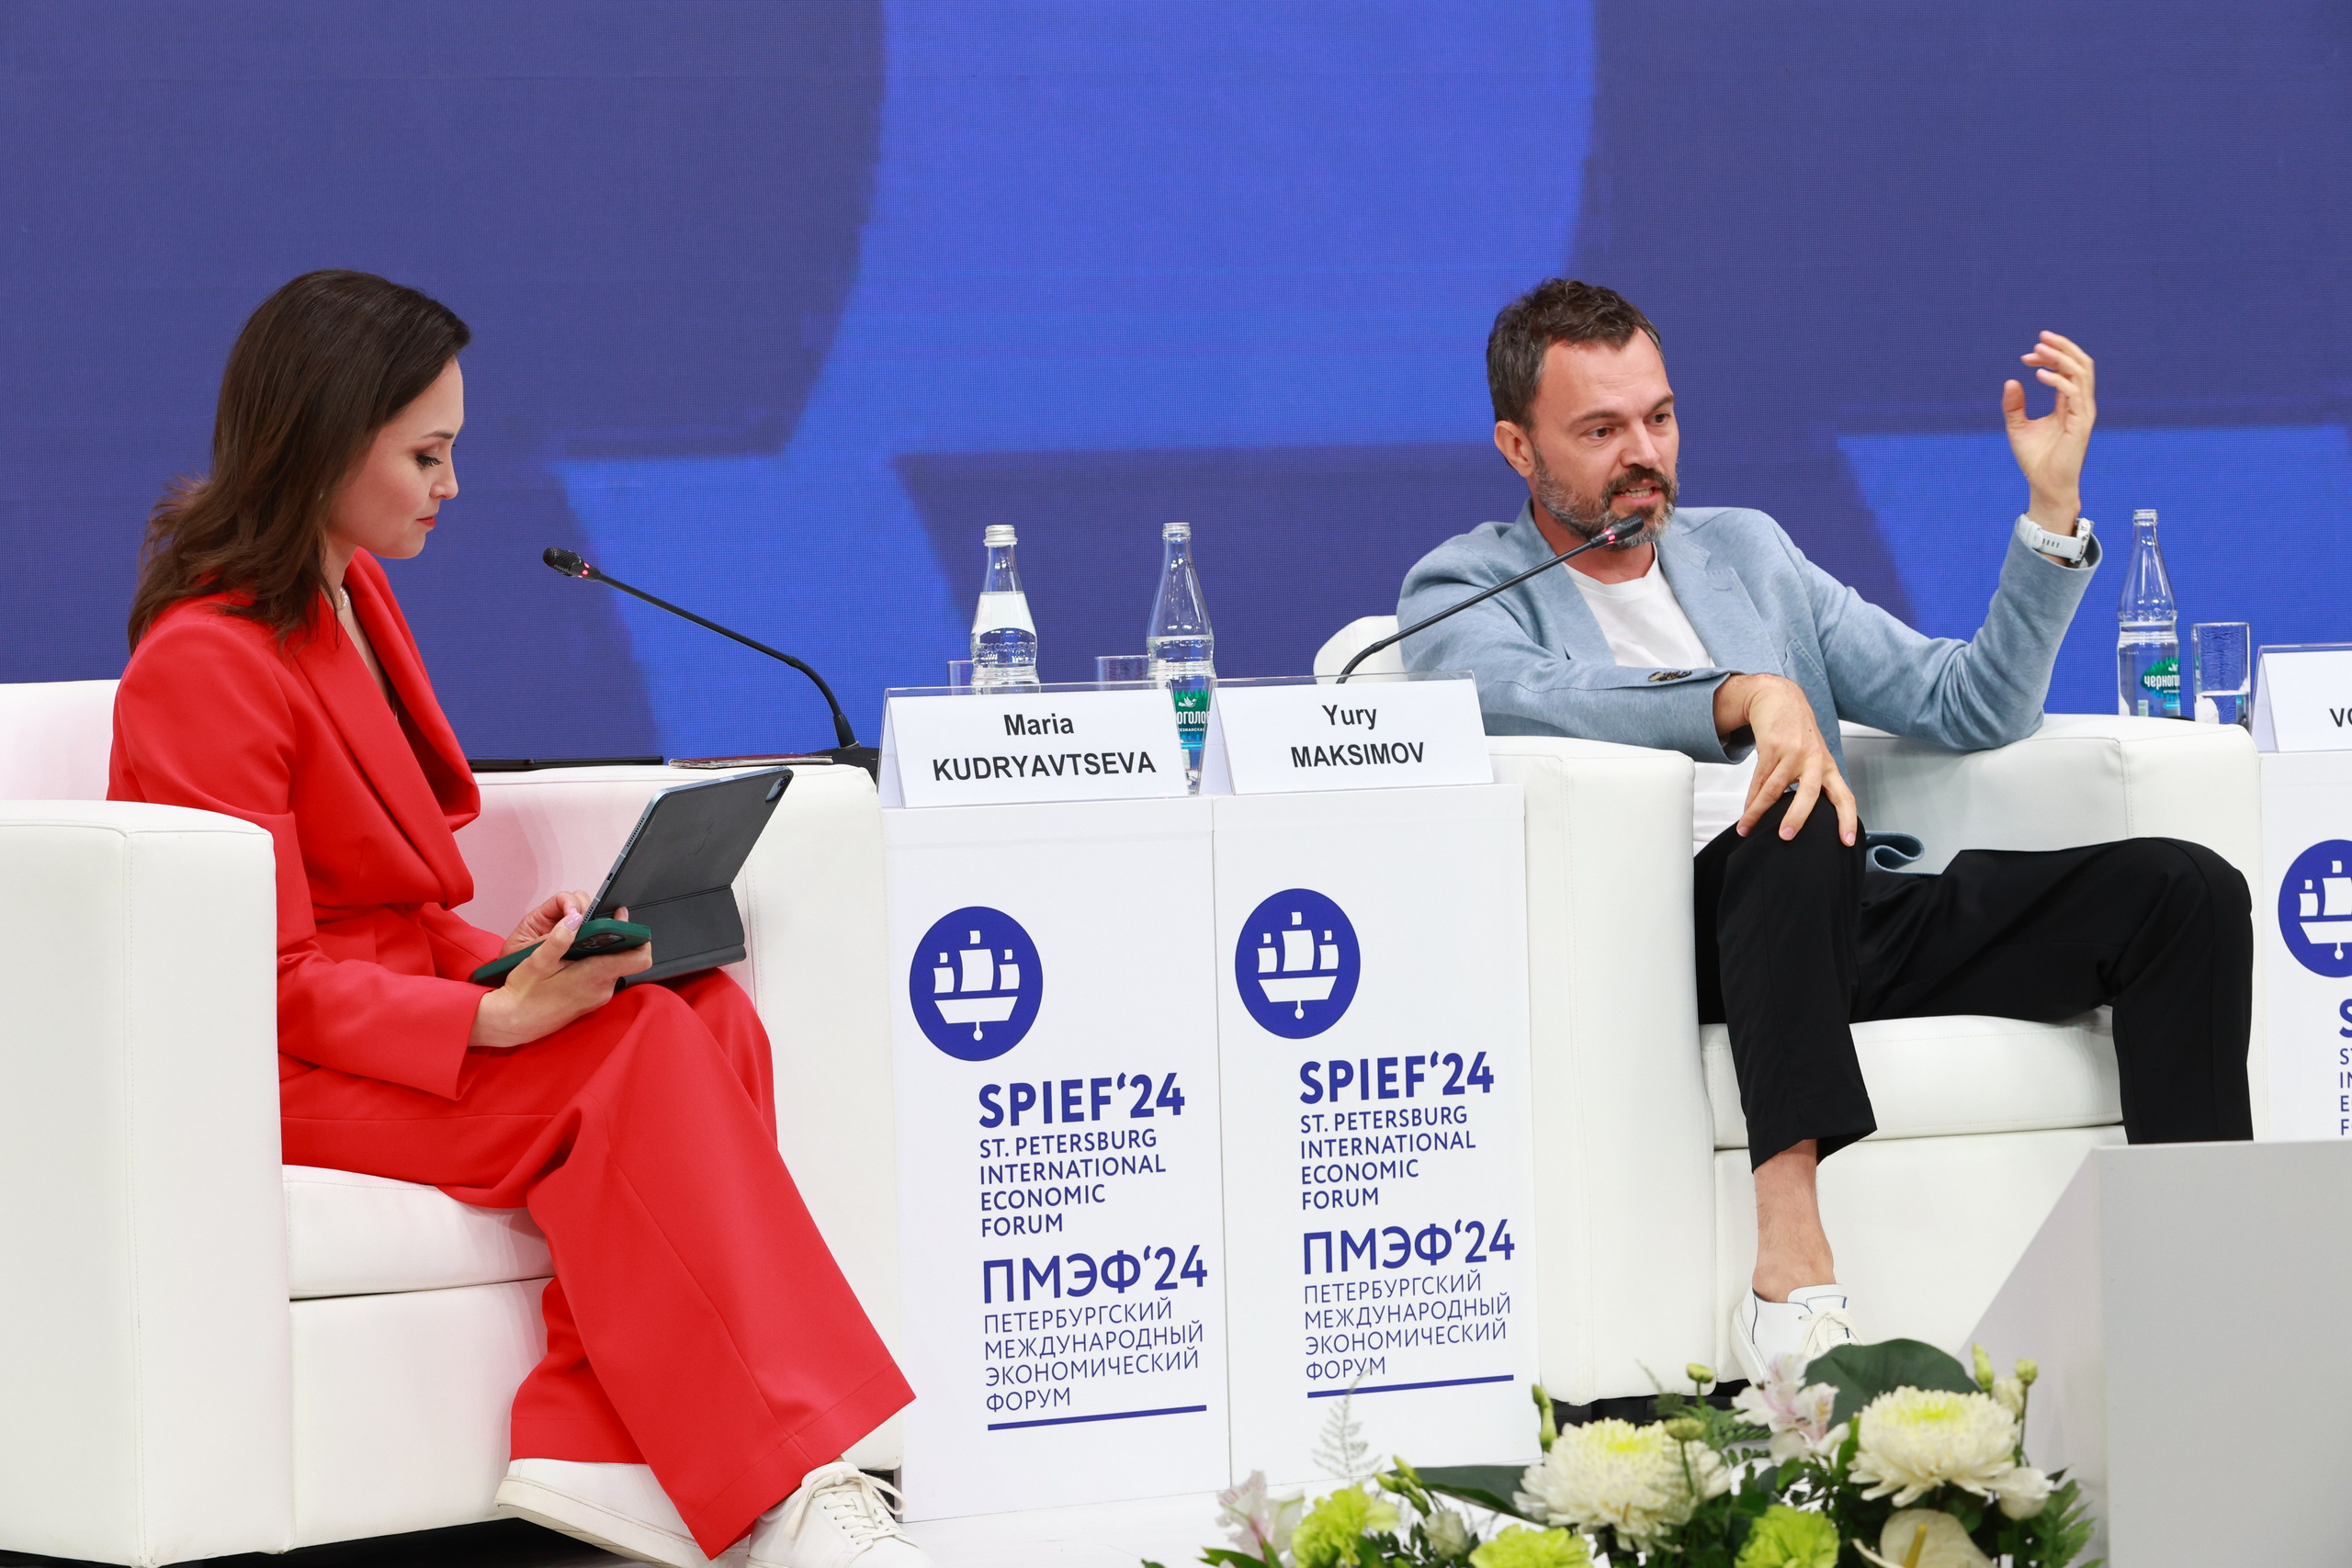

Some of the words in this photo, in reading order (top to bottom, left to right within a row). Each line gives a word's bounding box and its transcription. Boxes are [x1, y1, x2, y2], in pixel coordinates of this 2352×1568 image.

[1003, 713, 1075, 737] Maria
[1321, 704, 1377, 730] Yury
[2329, 707, 2352, 728] V
[933, 750, 1157, 782] KUDRYAVTSEVA
[1290, 741, 1424, 768] MAKSIMOV
[1300, 1113, 1329, 1134] ST.
[1334, 1105, 1467, 1132] PETERSBURG
[979, 1138, 1010, 1159] ST.
[1015, 1128, 1157, 1156] PETERSBURG
[1301, 1130, 1476, 1160] INTERNATIONAL
[980, 1154, 1167, 1185] INTERNATIONAL
[1301, 1158, 1419, 1185] ECONOMIC
[980, 1183, 1106, 1212] ECONOMIC
[1302, 1187, 1379, 1211] FORUM
[981, 1213, 1063, 1238] FORUM
[1305, 1269, 1481, 1304] ПЕТЕРБУРГСКИЙ
[984, 1296, 1172, 1335] ПЕТЕРБУРГСКИЙ
[1305, 1292, 1510, 1330] МЕЖДУНАРОДНЫЙ
[985, 1319, 1203, 1360] МЕЖДУНАРОДНЫЙ
[1306, 1317, 1506, 1356] ЭКОНОМИЧЕСКИЙ
[985, 1346, 1198, 1387] ЭКОНОМИЧЕСКИЙ
[1306, 1356, 1385, 1381] ФОРУМ
[986, 1386, 1070, 1413] ФОРУМ
